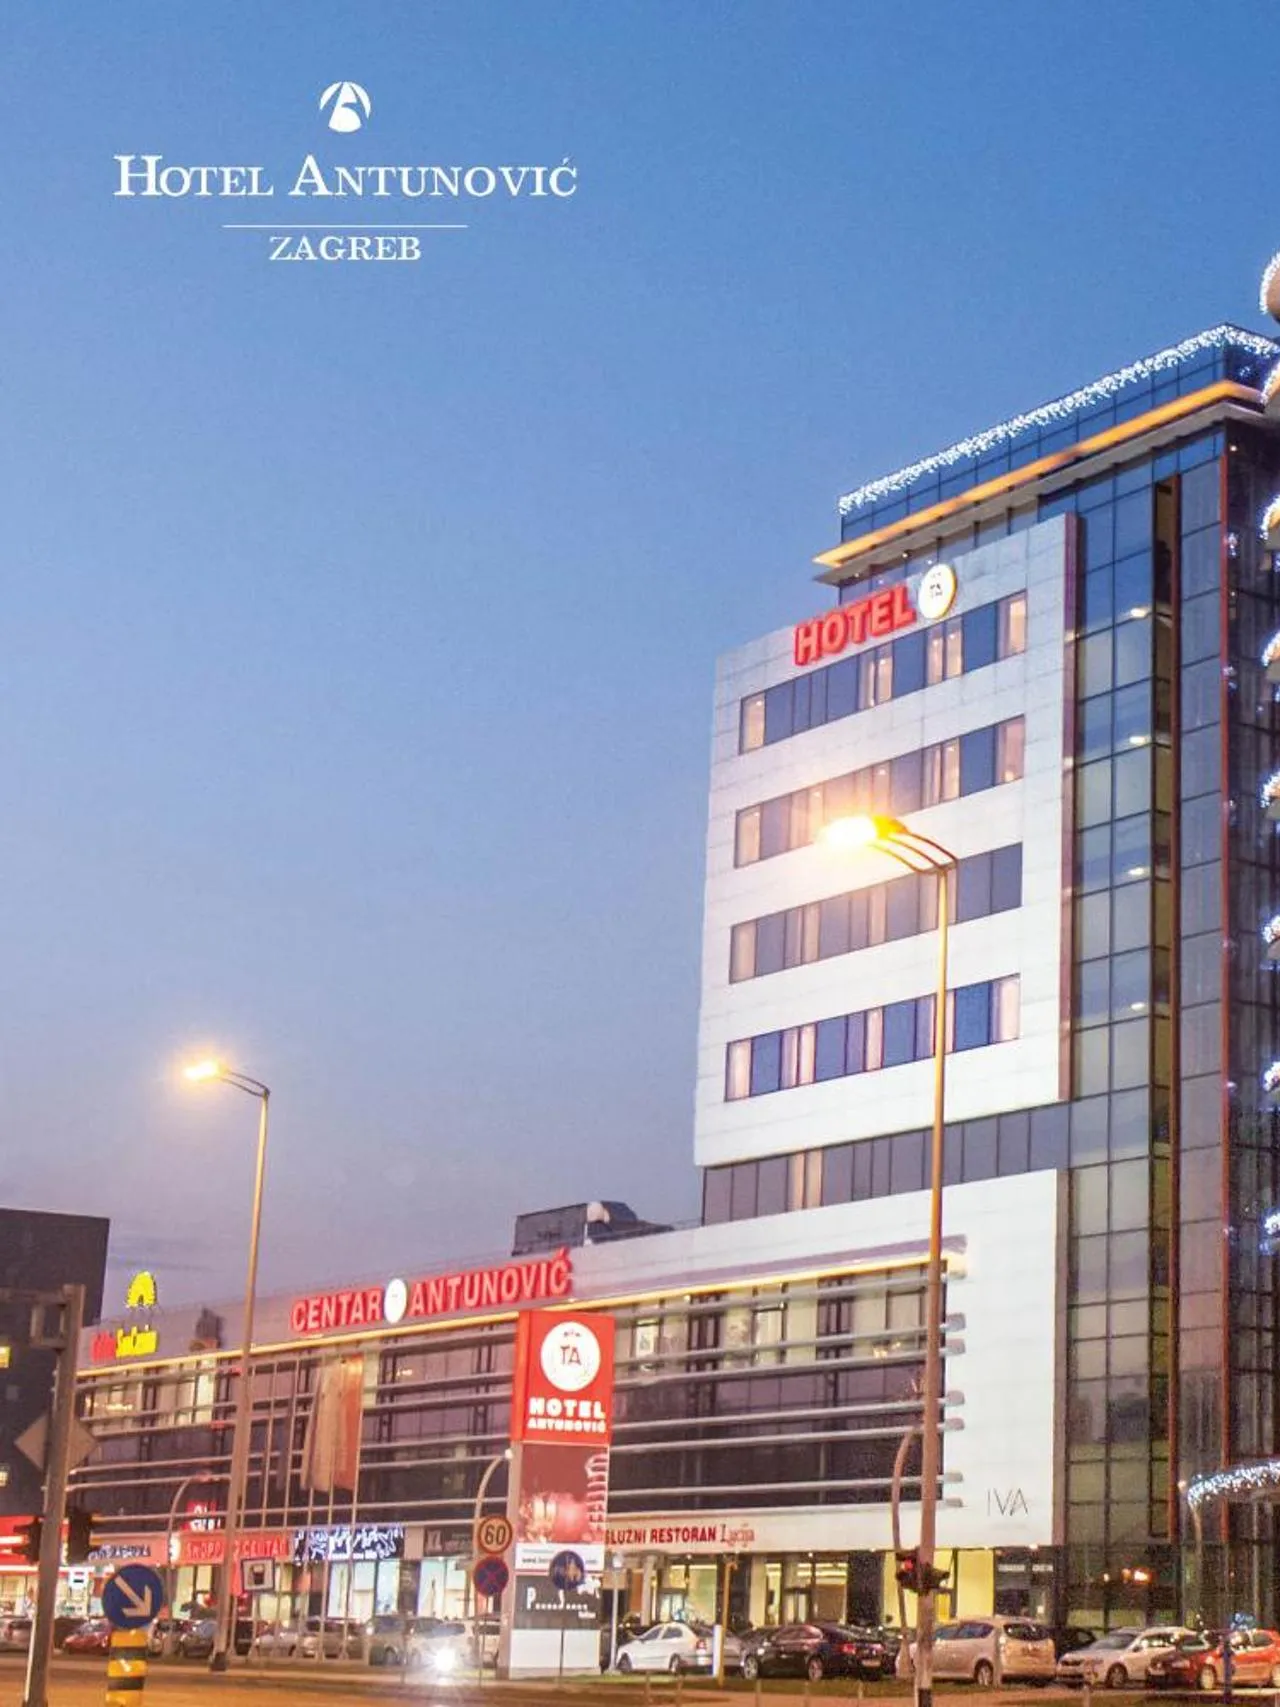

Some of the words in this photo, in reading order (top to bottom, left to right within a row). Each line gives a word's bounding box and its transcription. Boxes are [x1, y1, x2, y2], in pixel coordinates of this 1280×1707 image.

[794, 584, 917, 666] HOTEL
[290, 1287, 384, 1335] CENTAR
[408, 1247, 571, 1318] ANTUNOVIĆ
[528, 1396, 607, 1420] HOTEL
[986, 1486, 1029, 1517] IVA
[484, 1524, 507, 1546] 60
[650, 1526, 717, 1544] RESTORAN
